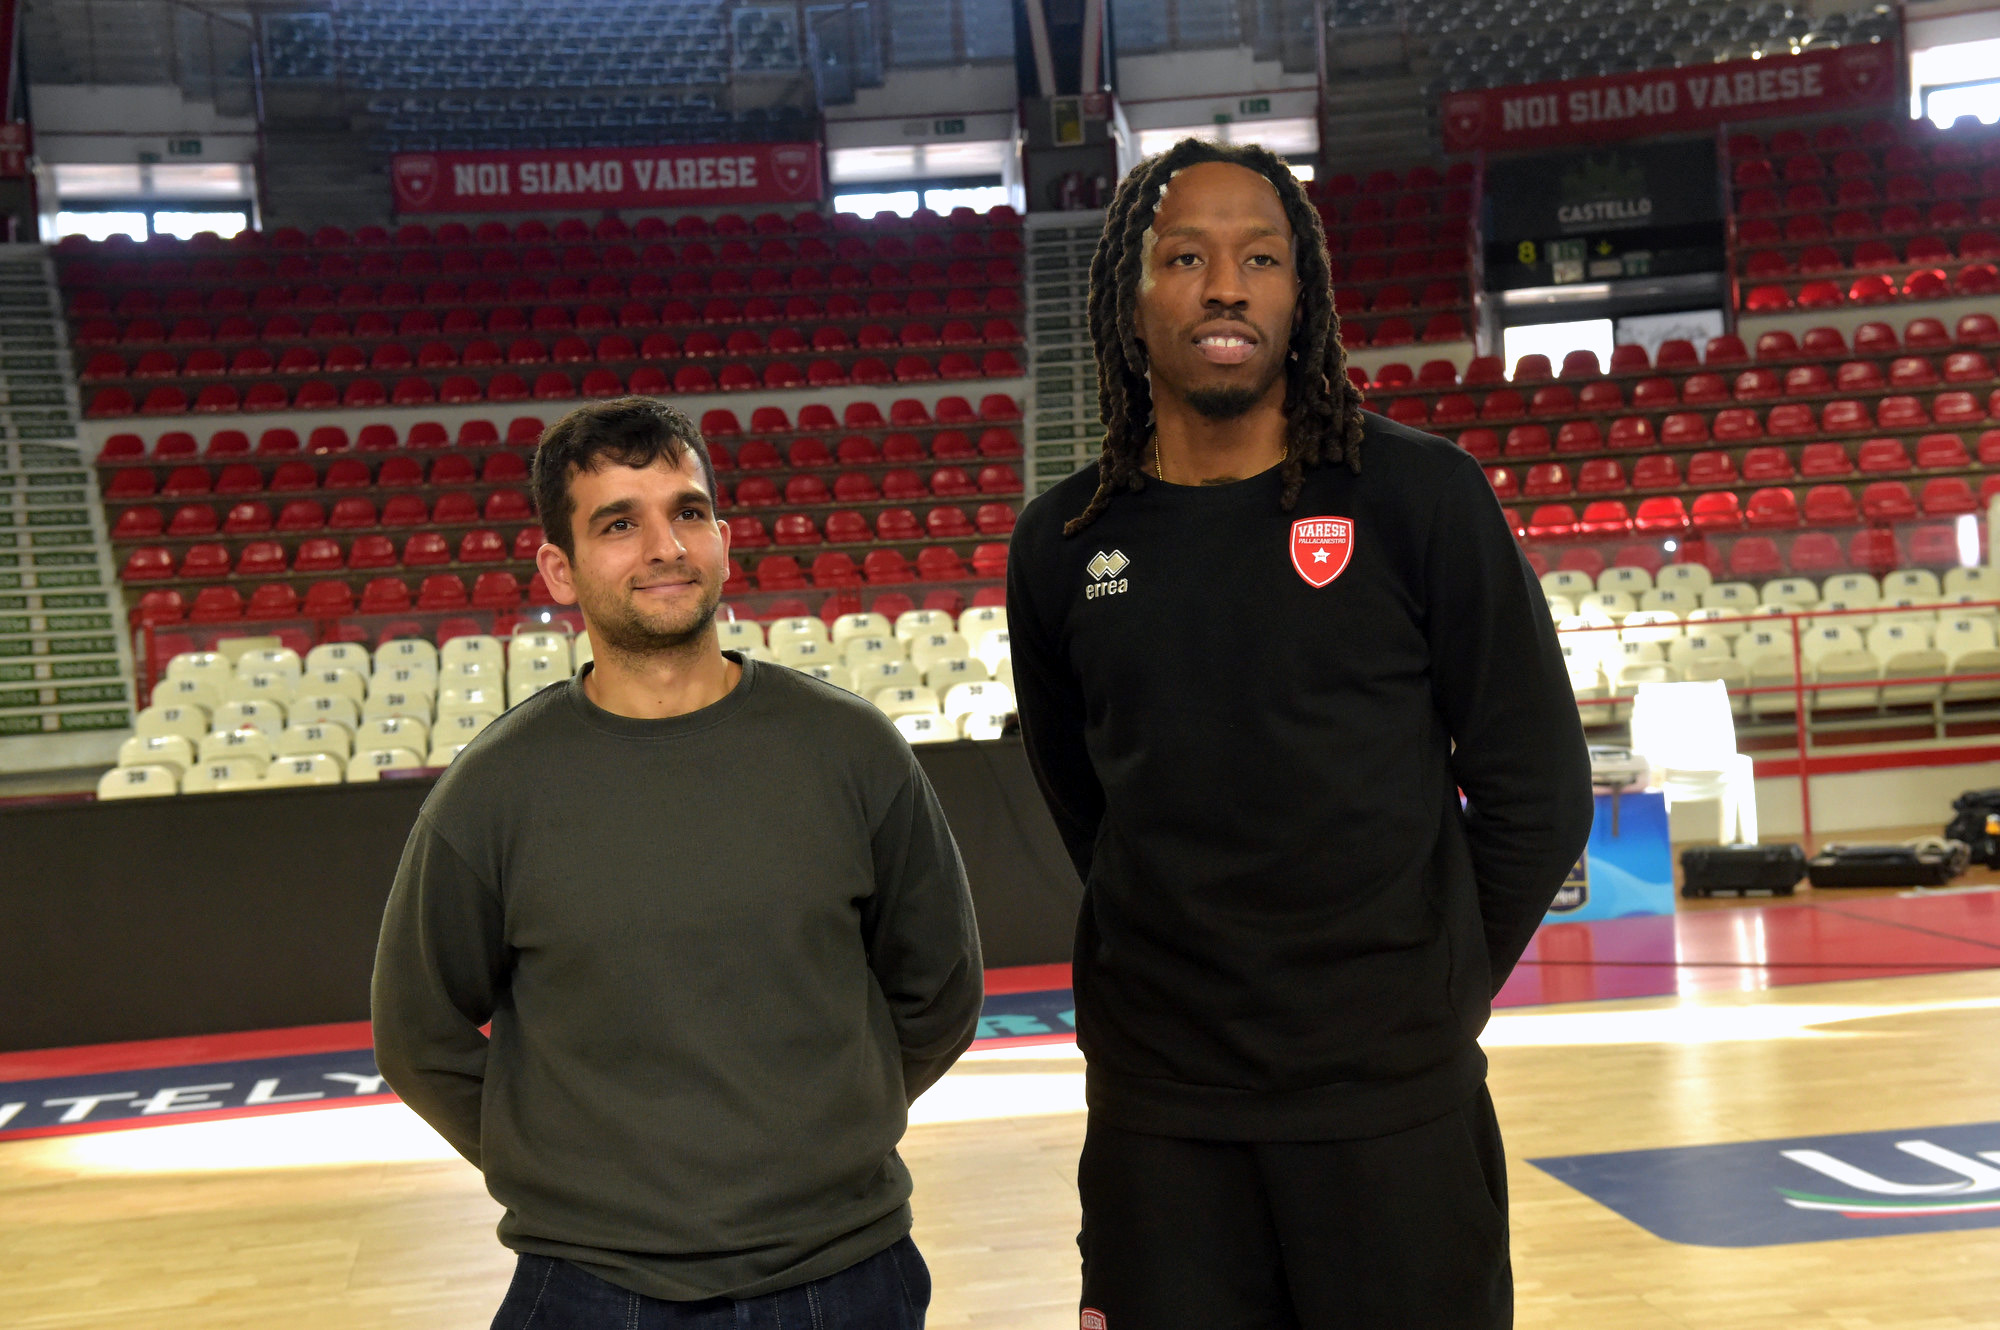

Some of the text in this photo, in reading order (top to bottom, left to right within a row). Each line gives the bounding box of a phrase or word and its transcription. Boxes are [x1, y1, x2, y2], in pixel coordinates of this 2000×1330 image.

[1502, 63, 1823, 131] NOI SIAMO VARESE
[453, 156, 758, 195] NOI SIAMO VARESE
[1557, 198, 1652, 222] CASTELLO
[1517, 240, 1536, 264] 8
[1298, 523, 1346, 537] VARESE
[915, 720, 930, 730] 30
